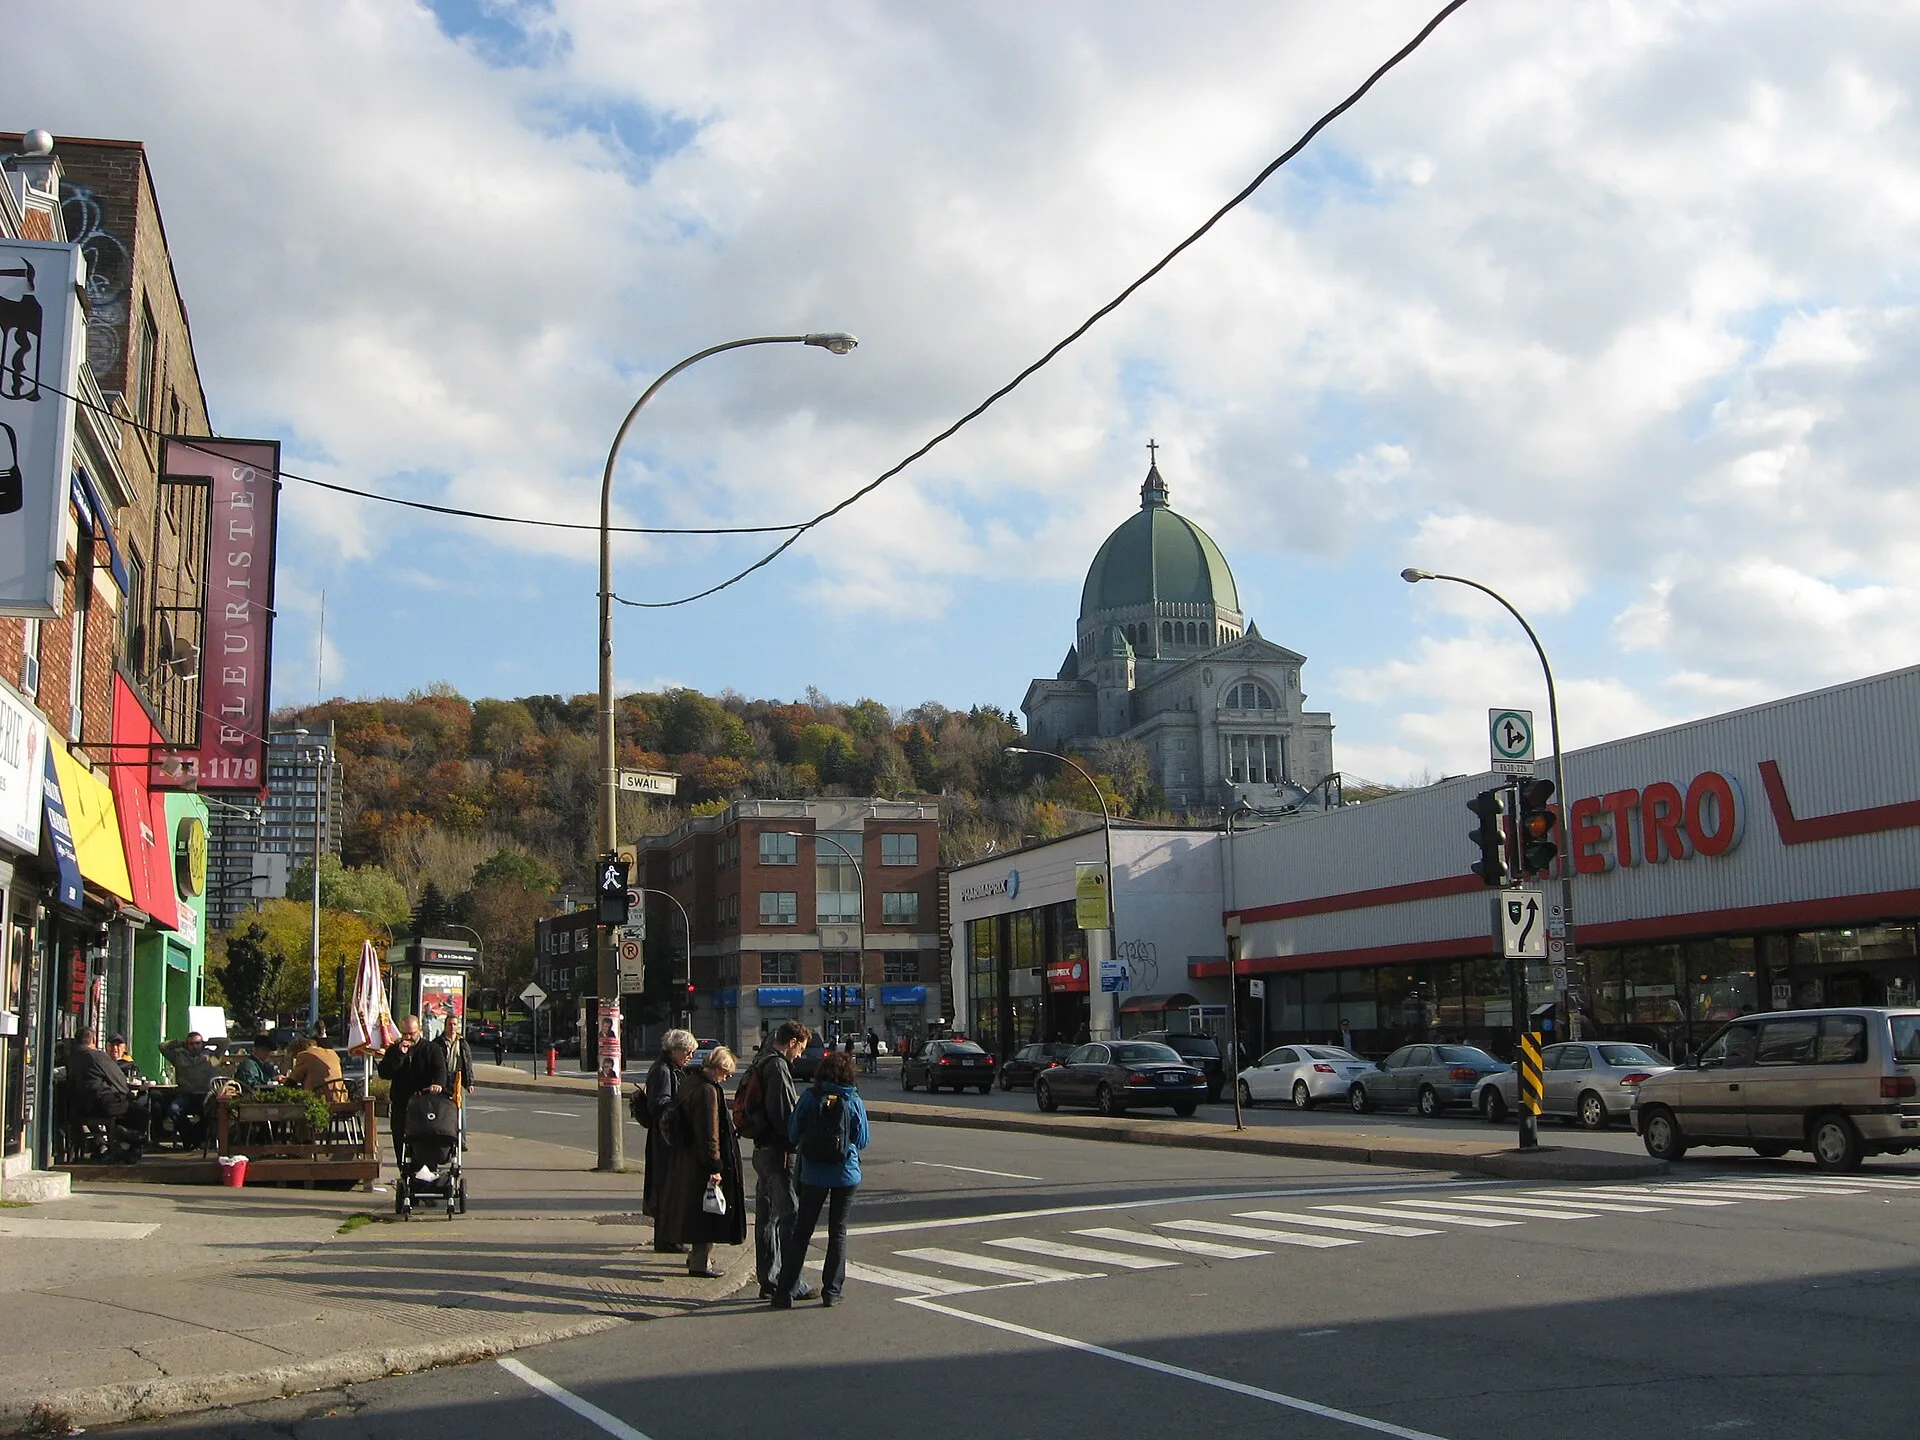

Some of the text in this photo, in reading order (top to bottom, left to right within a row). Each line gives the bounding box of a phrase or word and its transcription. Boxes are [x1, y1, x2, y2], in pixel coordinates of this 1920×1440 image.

[220, 465, 256, 745] FLEURISTES
[627, 777, 659, 790] SWAIL
[1503, 771, 1742, 881] ETRO
[960, 879, 1008, 901] PHARMAPRIX
